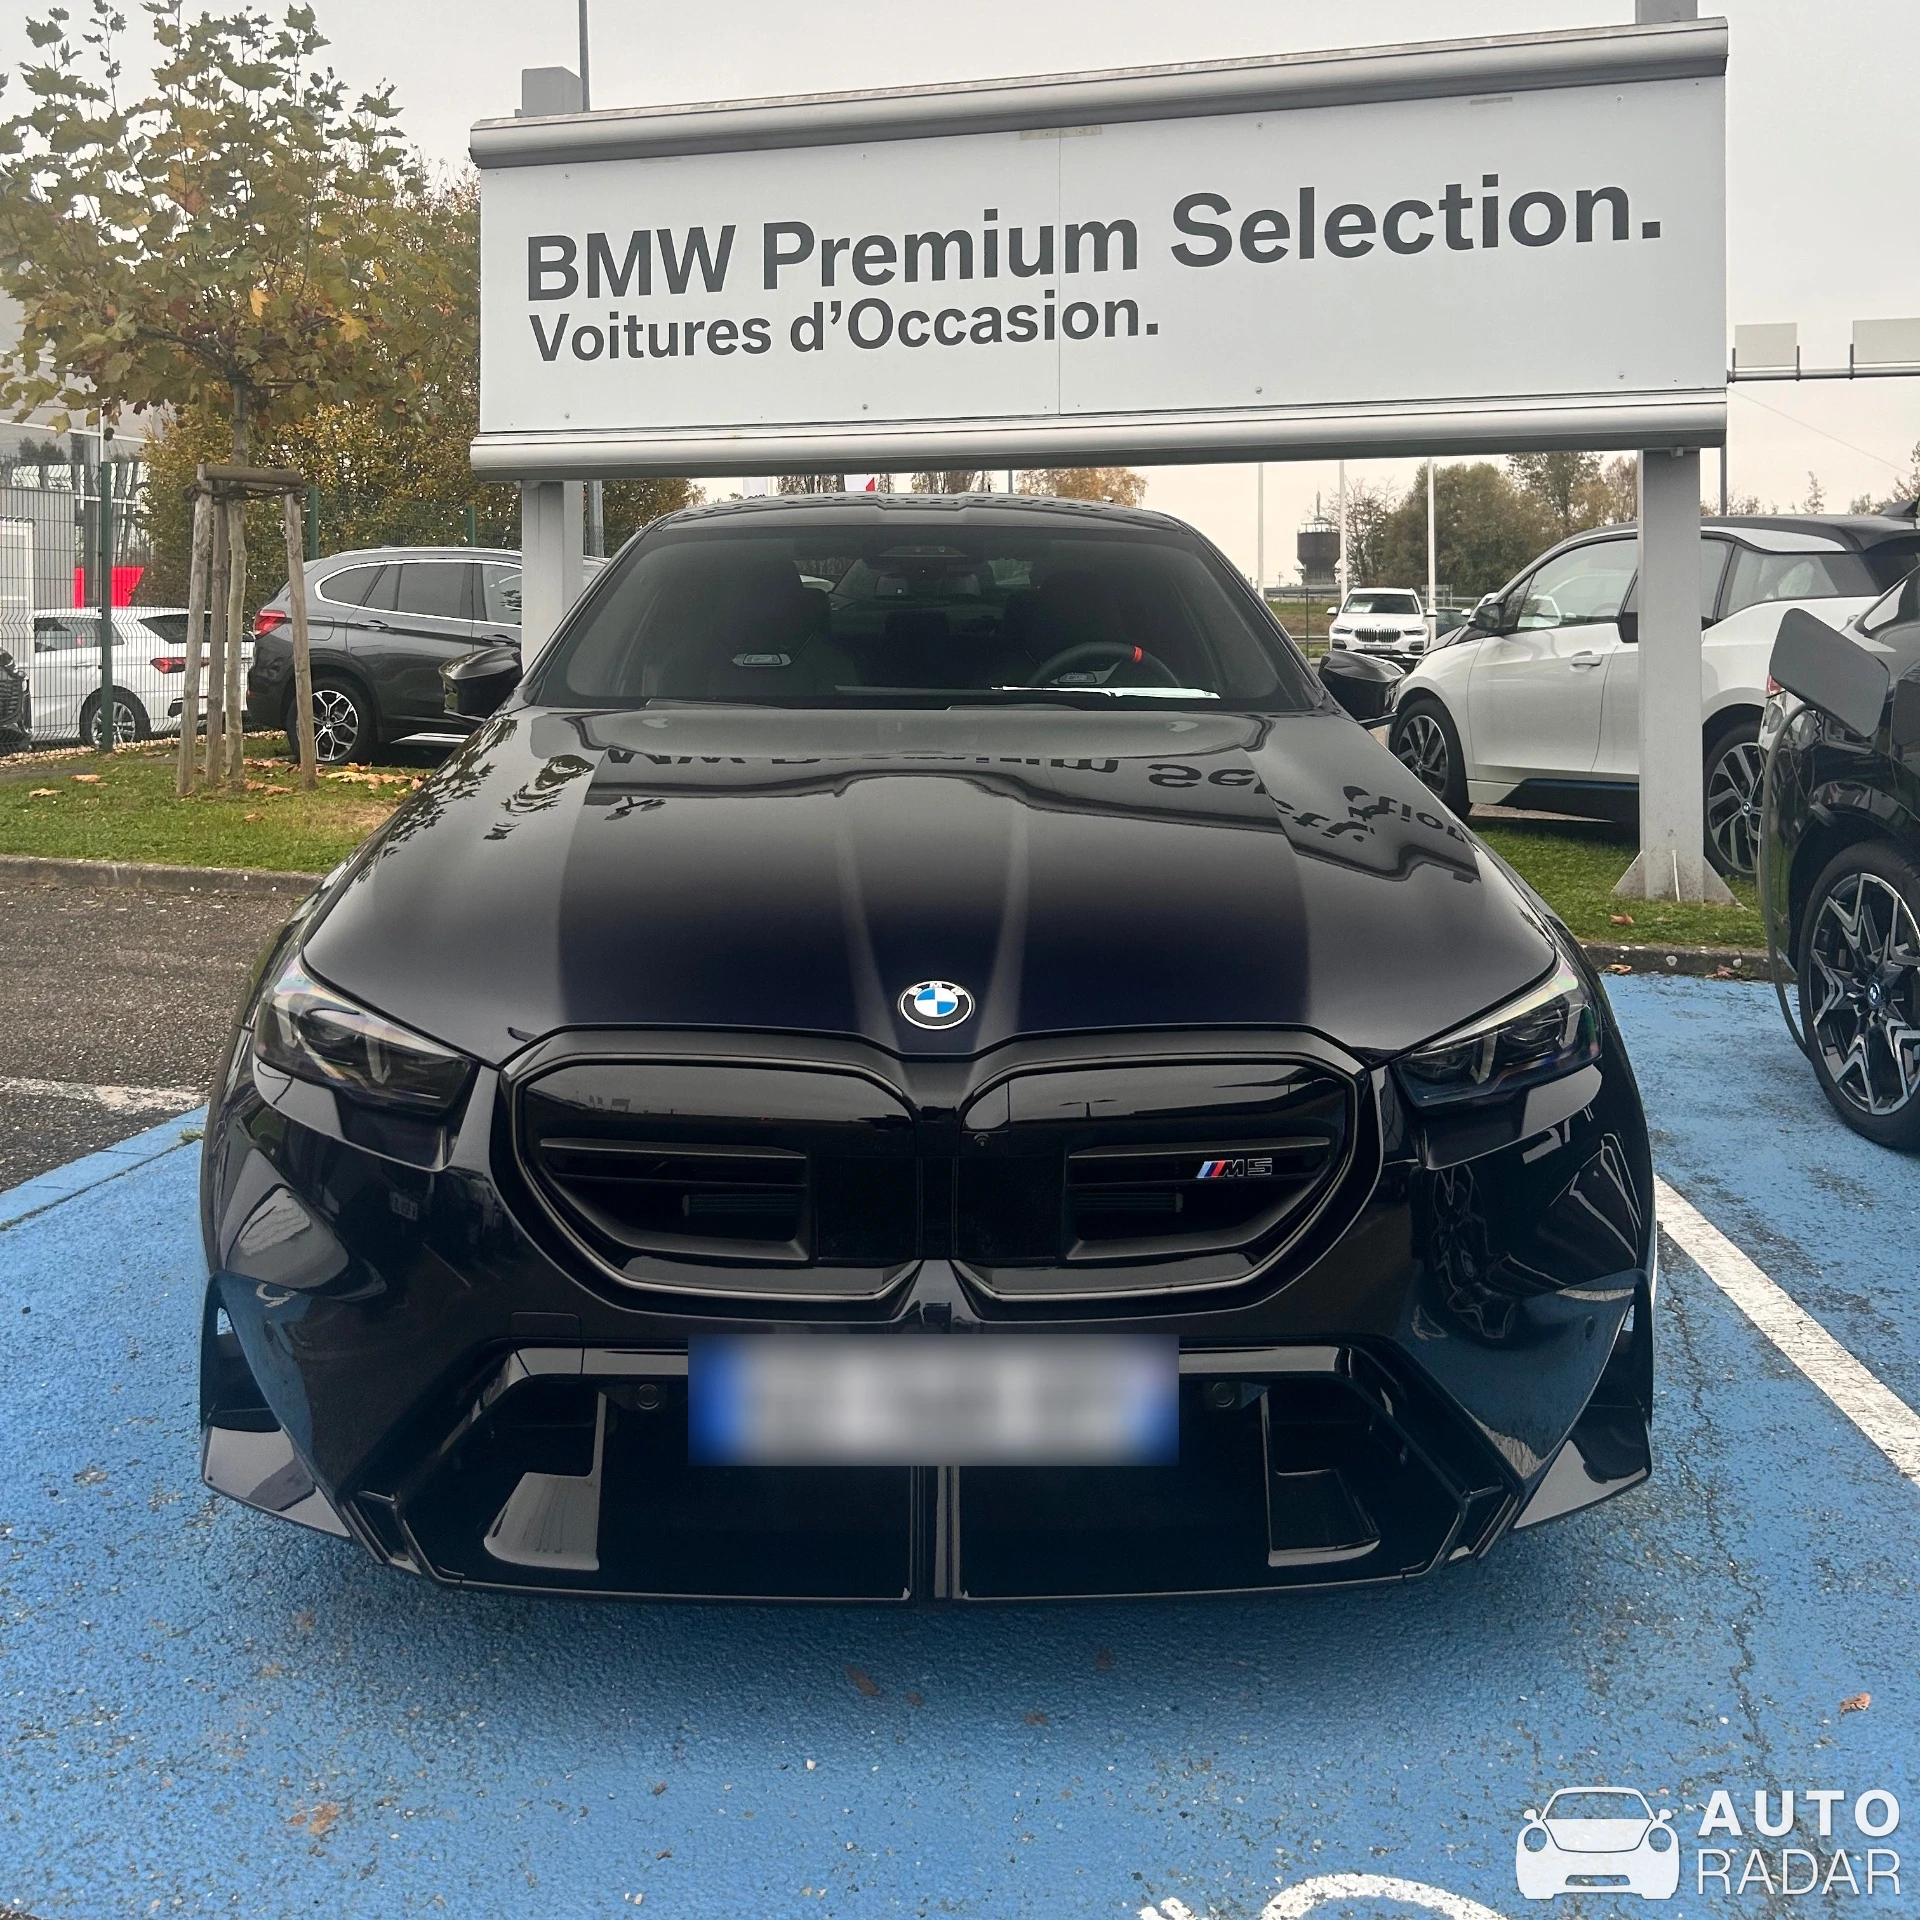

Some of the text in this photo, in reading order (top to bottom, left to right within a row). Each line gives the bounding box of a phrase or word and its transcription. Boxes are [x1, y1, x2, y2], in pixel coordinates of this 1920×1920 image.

[527, 173, 1661, 302] BMW Premium Selection.
[528, 314, 772, 362] Voitures
[1217, 1158, 1273, 1178] M5
